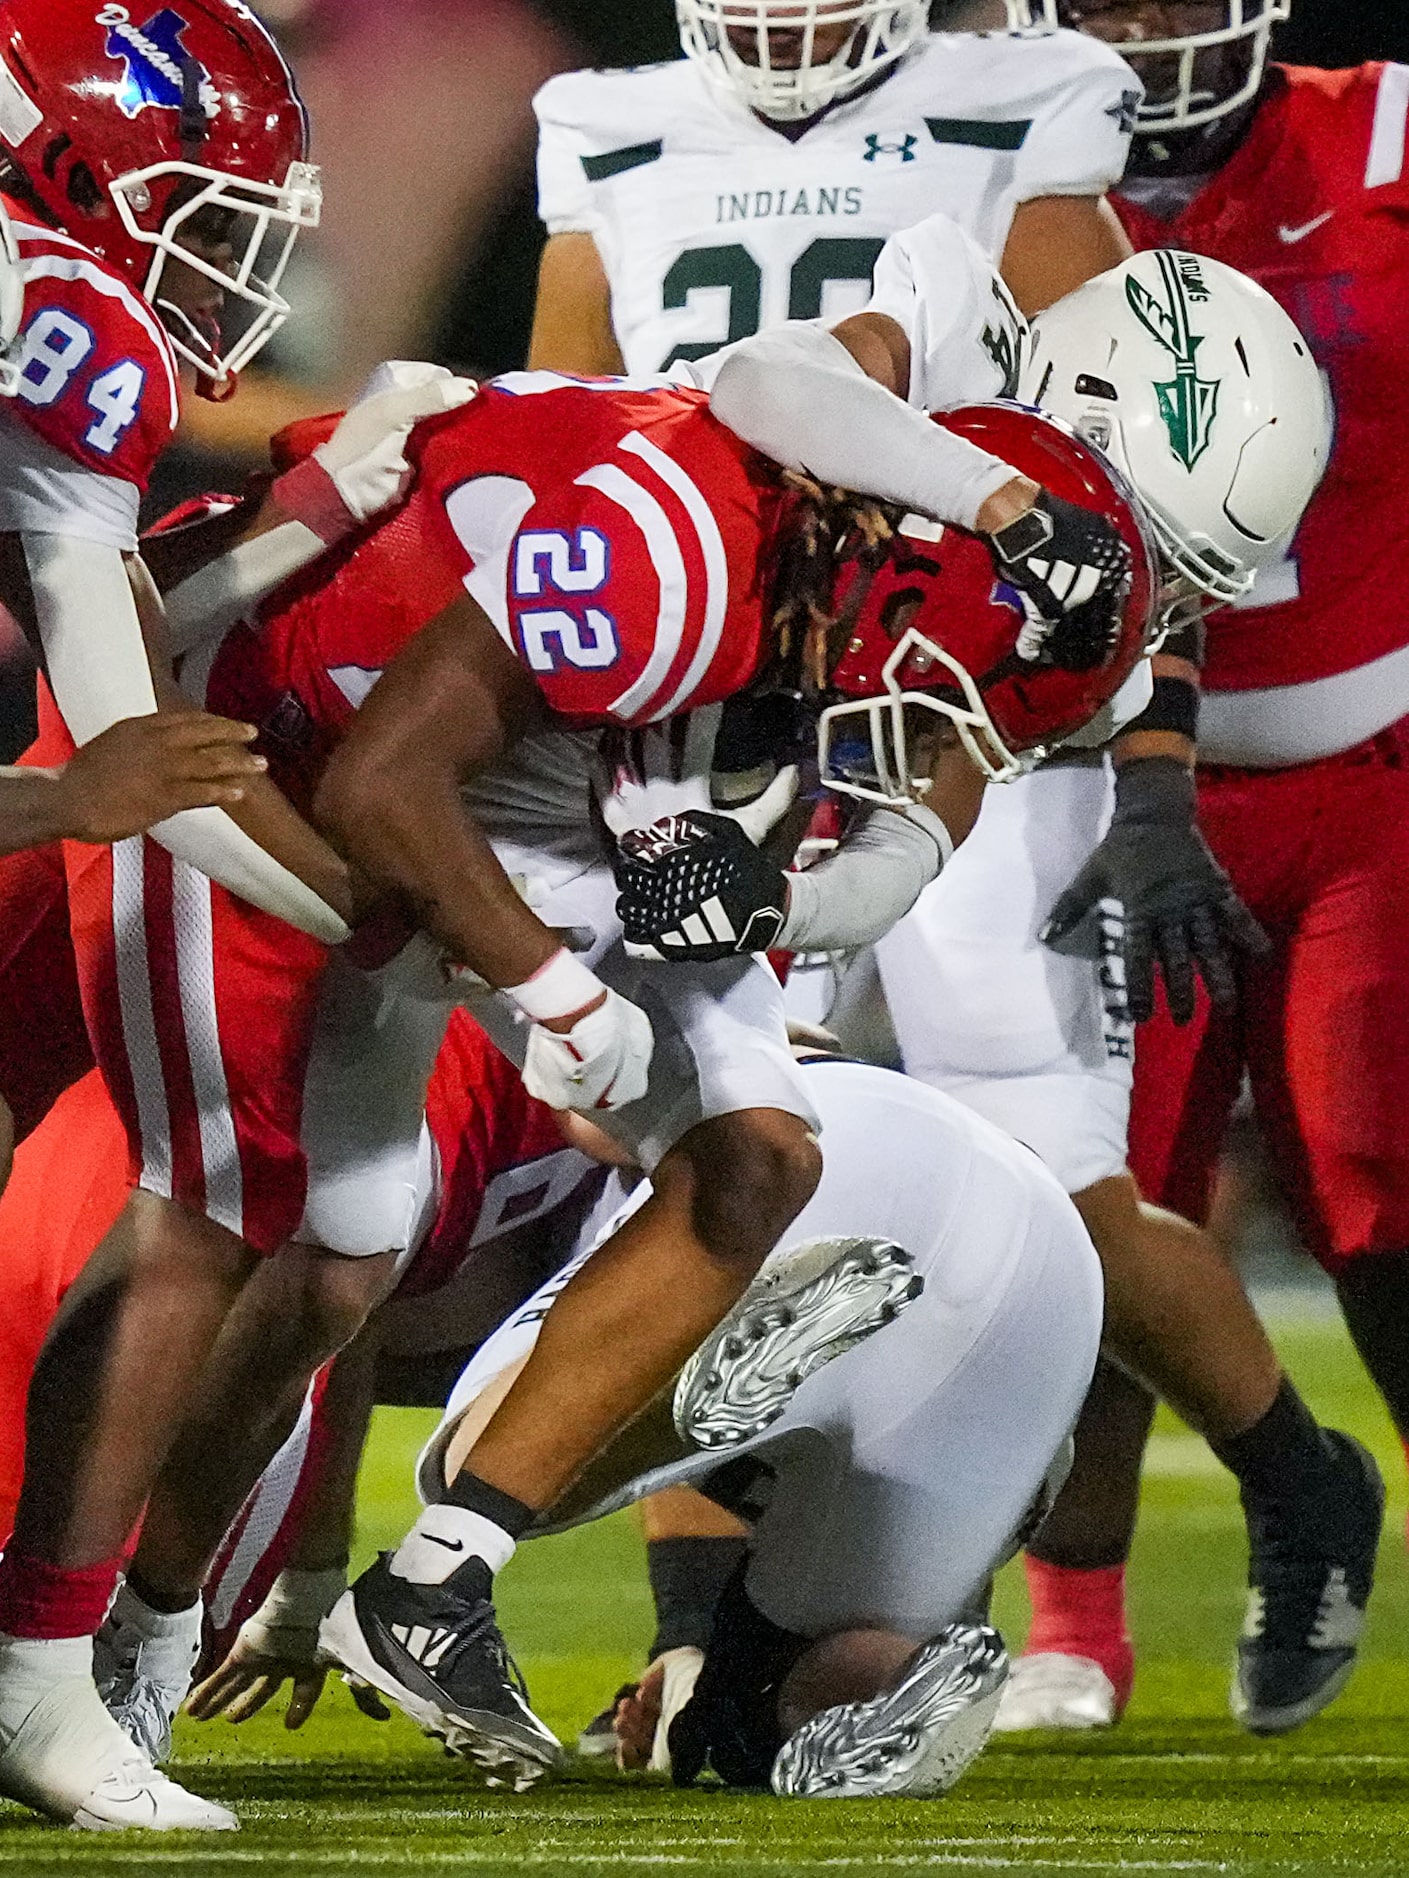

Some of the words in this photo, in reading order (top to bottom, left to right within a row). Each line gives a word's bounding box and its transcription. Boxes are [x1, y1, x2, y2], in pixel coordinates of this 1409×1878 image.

[717, 187, 863, 223] INDIANS
[17, 305, 147, 456] 84
[514, 526, 621, 673] 22
